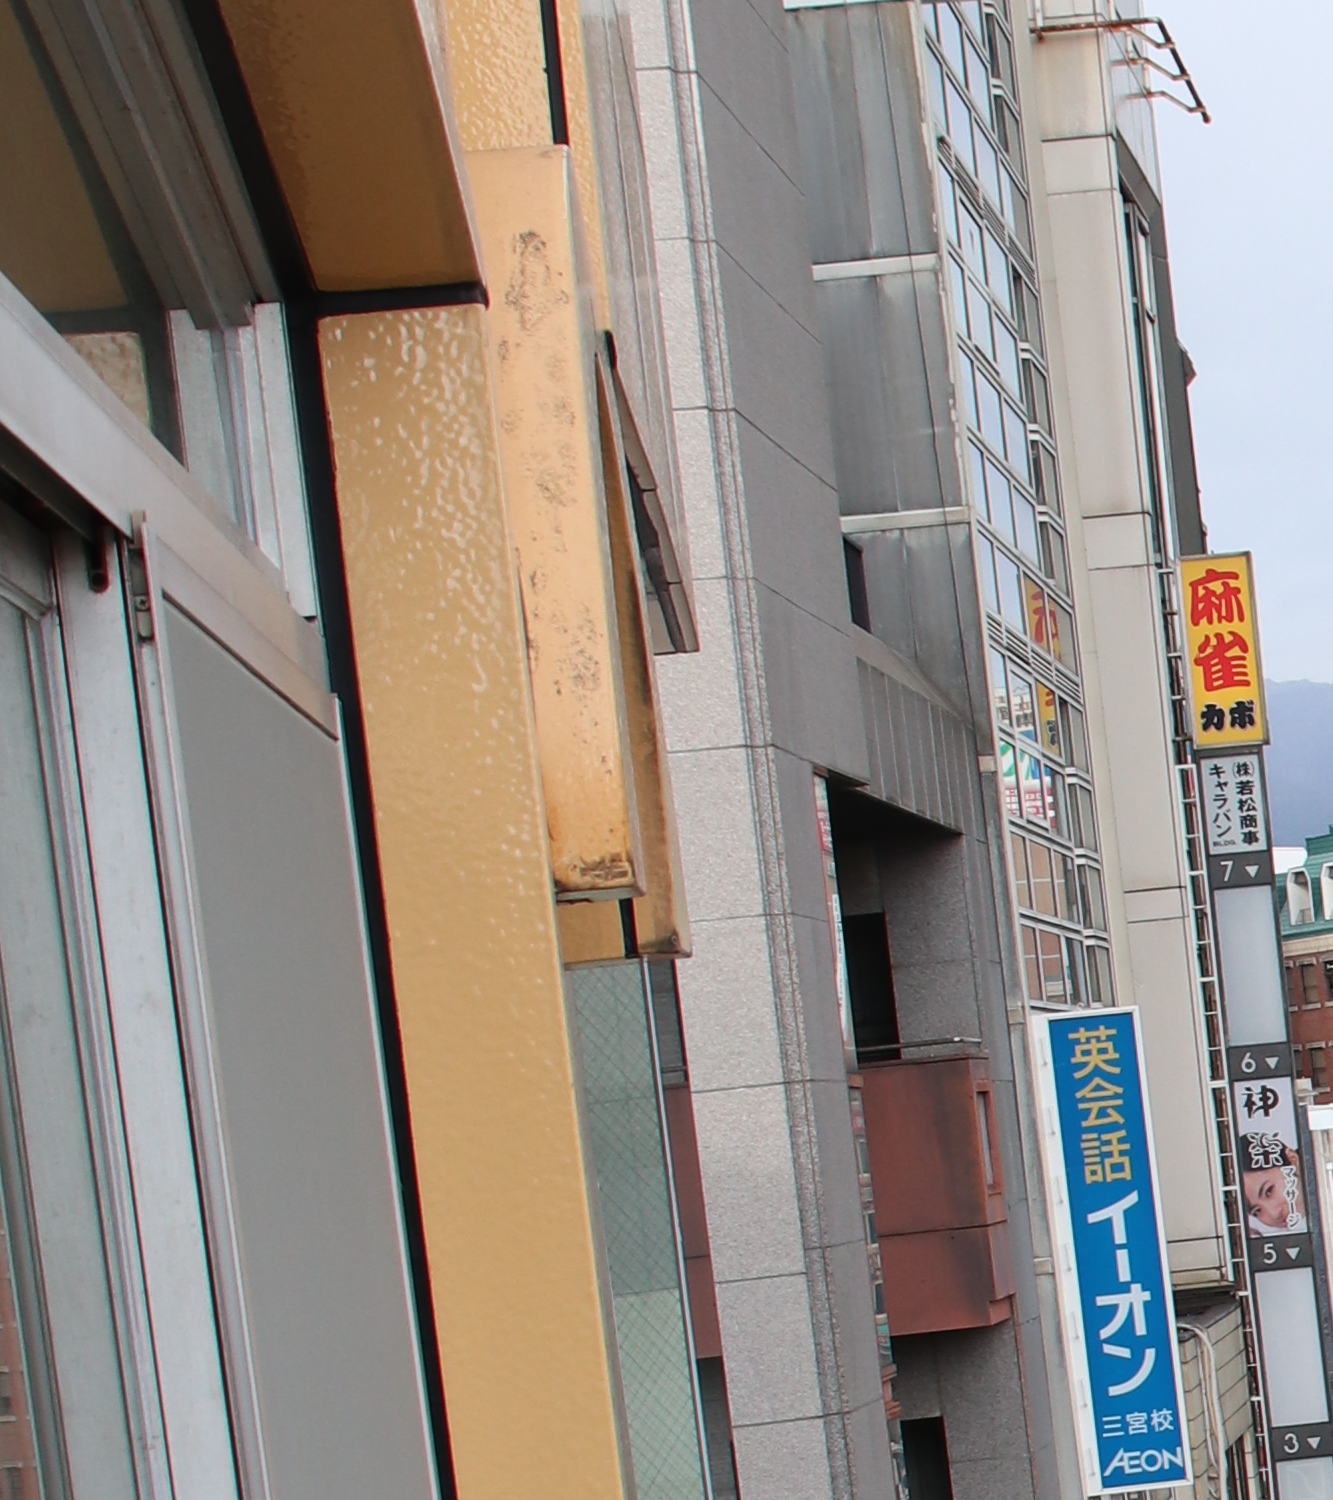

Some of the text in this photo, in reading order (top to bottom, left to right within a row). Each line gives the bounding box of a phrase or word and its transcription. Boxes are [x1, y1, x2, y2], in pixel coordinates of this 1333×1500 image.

[1188, 568, 1252, 693] 麻雀
[1200, 699, 1257, 733] カボ
[1208, 763, 1233, 839] キャラバン
[1218, 860, 1235, 882] 7
[1240, 1052, 1257, 1074] 6
[1068, 1024, 1134, 1185] 英会話
[1281, 1165, 1300, 1230] マッサージ
[1262, 1243, 1278, 1265] 5
[1086, 1188, 1157, 1397] イーオン
[1102, 1408, 1175, 1438] 三宮校
[1283, 1433, 1299, 1455] 3
